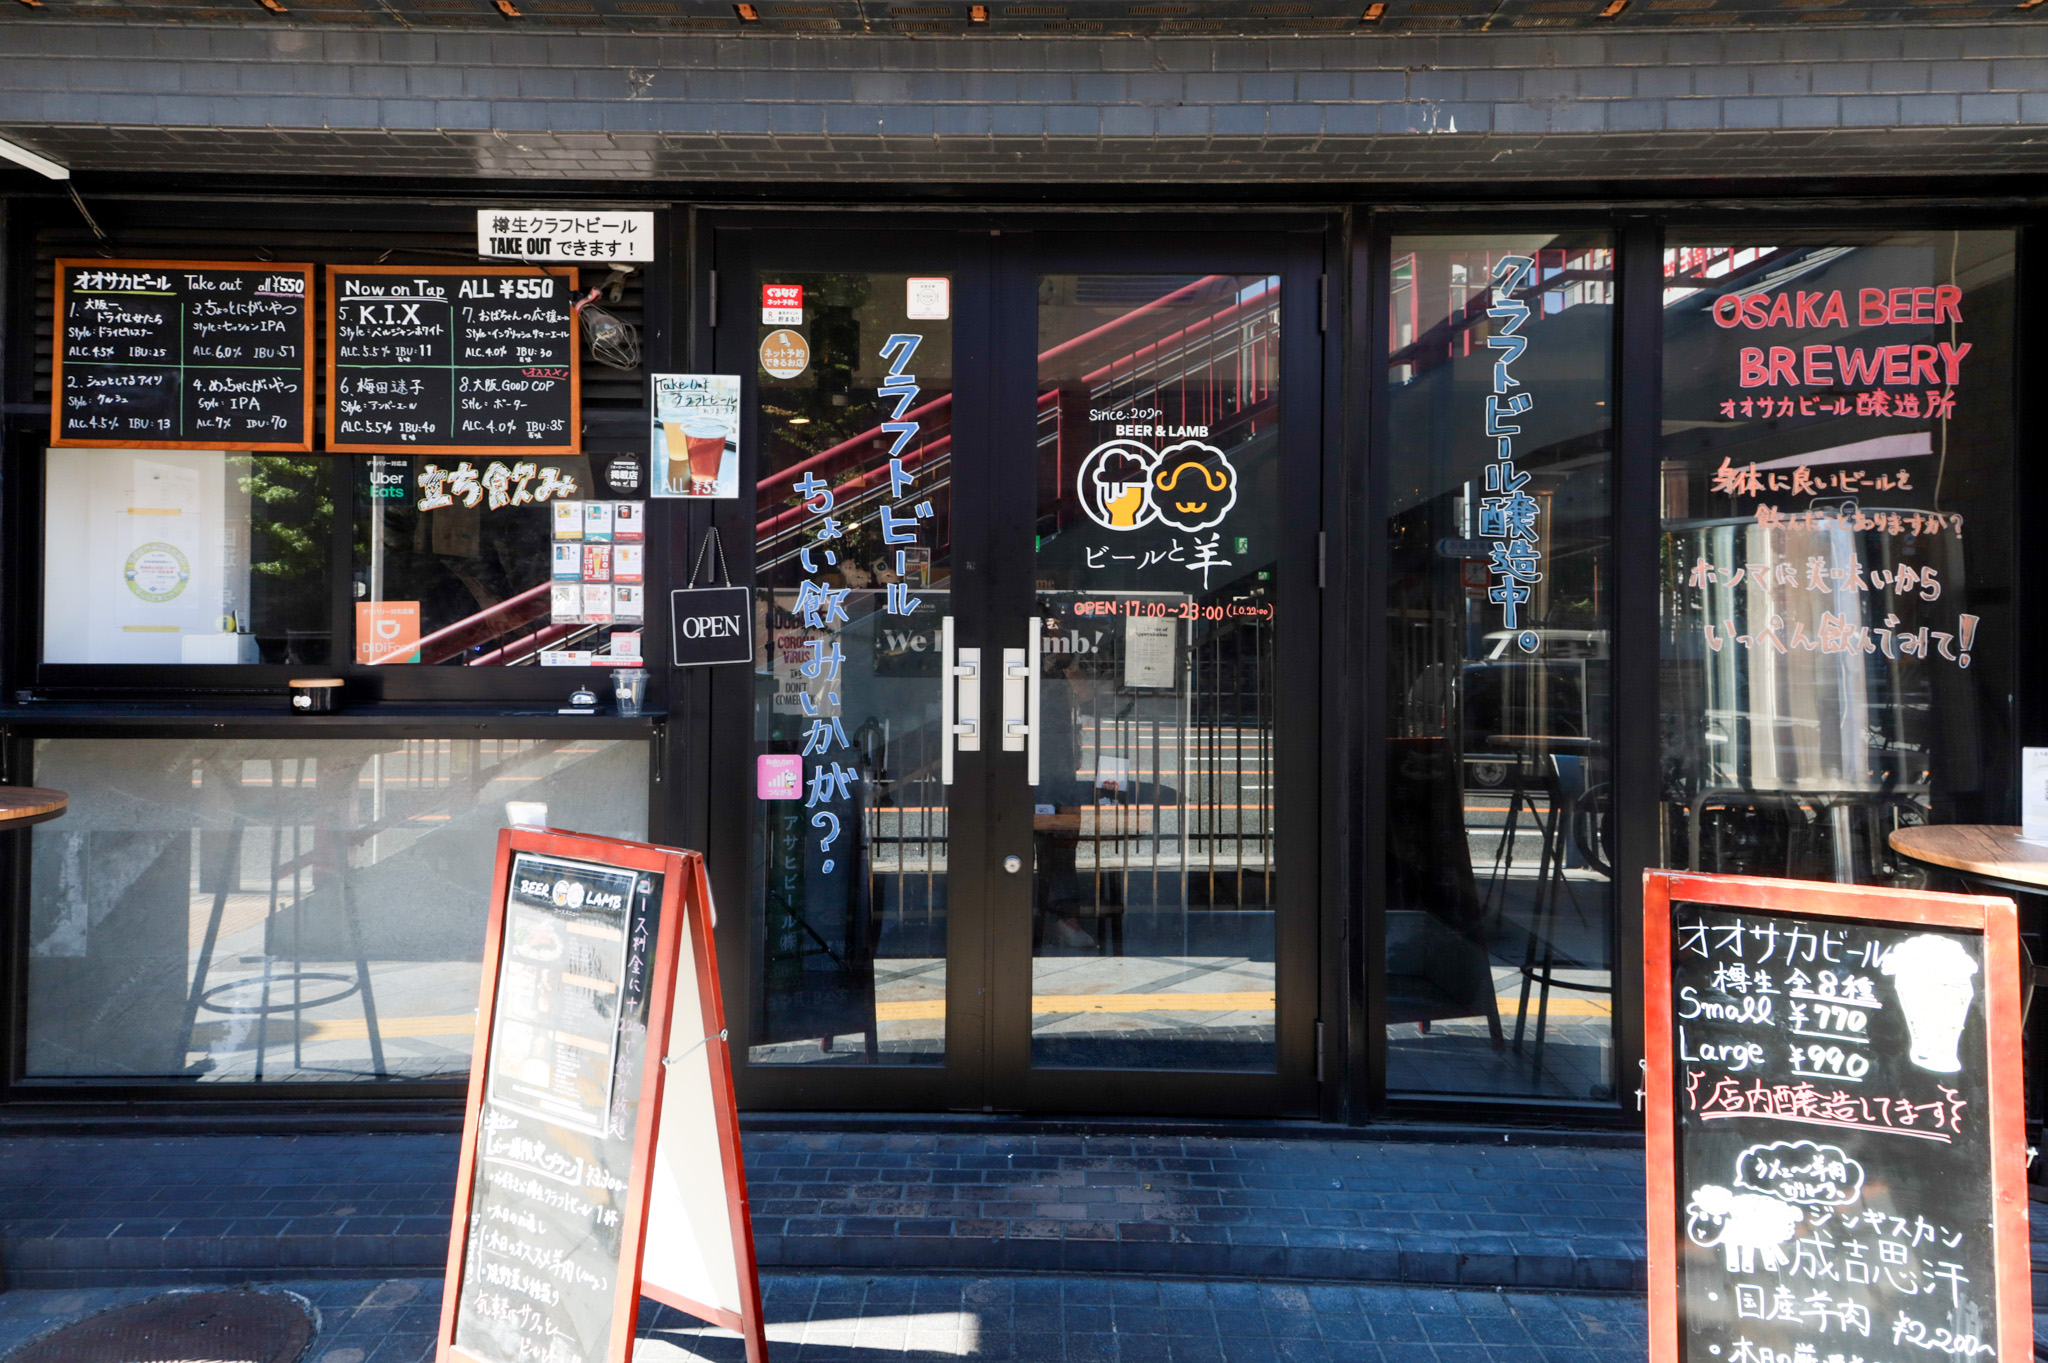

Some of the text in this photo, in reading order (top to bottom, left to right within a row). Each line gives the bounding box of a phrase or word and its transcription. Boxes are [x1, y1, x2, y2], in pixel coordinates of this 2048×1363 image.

[492, 215, 638, 234] 樽生クラフトビール
[489, 237, 522, 255] TAKE
[527, 237, 552, 255] OUT
[73, 270, 172, 291] オオサカビール
[184, 274, 243, 291] Take out
[345, 279, 445, 298] Now on Tap
[458, 278, 554, 299] ALL ¥550
[766, 288, 799, 298] ぐるなび
[204, 299, 297, 317] ちょっとにがいやつ
[359, 304, 421, 325] K.I.X
[1712, 285, 1963, 329] OSAKA BEER
[362, 345, 390, 358] 5.5%
[764, 348, 805, 358] ネット予約
[765, 358, 805, 368] できるお店
[1739, 342, 1973, 388] BREWERY
[208, 377, 298, 393] めっちゃにがいやつ
[357, 377, 424, 395] 梅田迷子
[473, 378, 501, 392] 大阪
[230, 396, 261, 411] IPA
[1719, 387, 1957, 420] オオサカビール醸造所
[486, 419, 517, 434] 4.0%
[1115, 424, 1209, 437] BEER & LAMB
[1479, 255, 1543, 654] クラフトビール醸造中。
[370, 471, 404, 484] Uber
[661, 477, 690, 494] ALL
[877, 333, 934, 617] クラフトビール
[370, 485, 405, 498] Eats
[417, 460, 578, 512] 立ち飲み
[1086, 532, 1233, 590] ビールと羊
[1689, 553, 1941, 601] ホンマに美味いから
[682, 615, 741, 639] OPEN
[883, 629, 927, 652] We
[766, 758, 794, 767] Rakuten
[767, 788, 793, 797] つながる
[521, 880, 622, 909] BEER LAMB
[1678, 917, 1889, 968] オオサカビール
[1711, 961, 1876, 999] 樽生 全8種
[1678, 985, 1868, 1032] Small ¥770
[1679, 1025, 1870, 1078] Large ¥990
[1809, 1205, 1963, 1249] ジンギスカン
[1789, 1230, 1970, 1309] 成吉思汗
[1735, 1283, 1870, 1337] 国産羊肉
